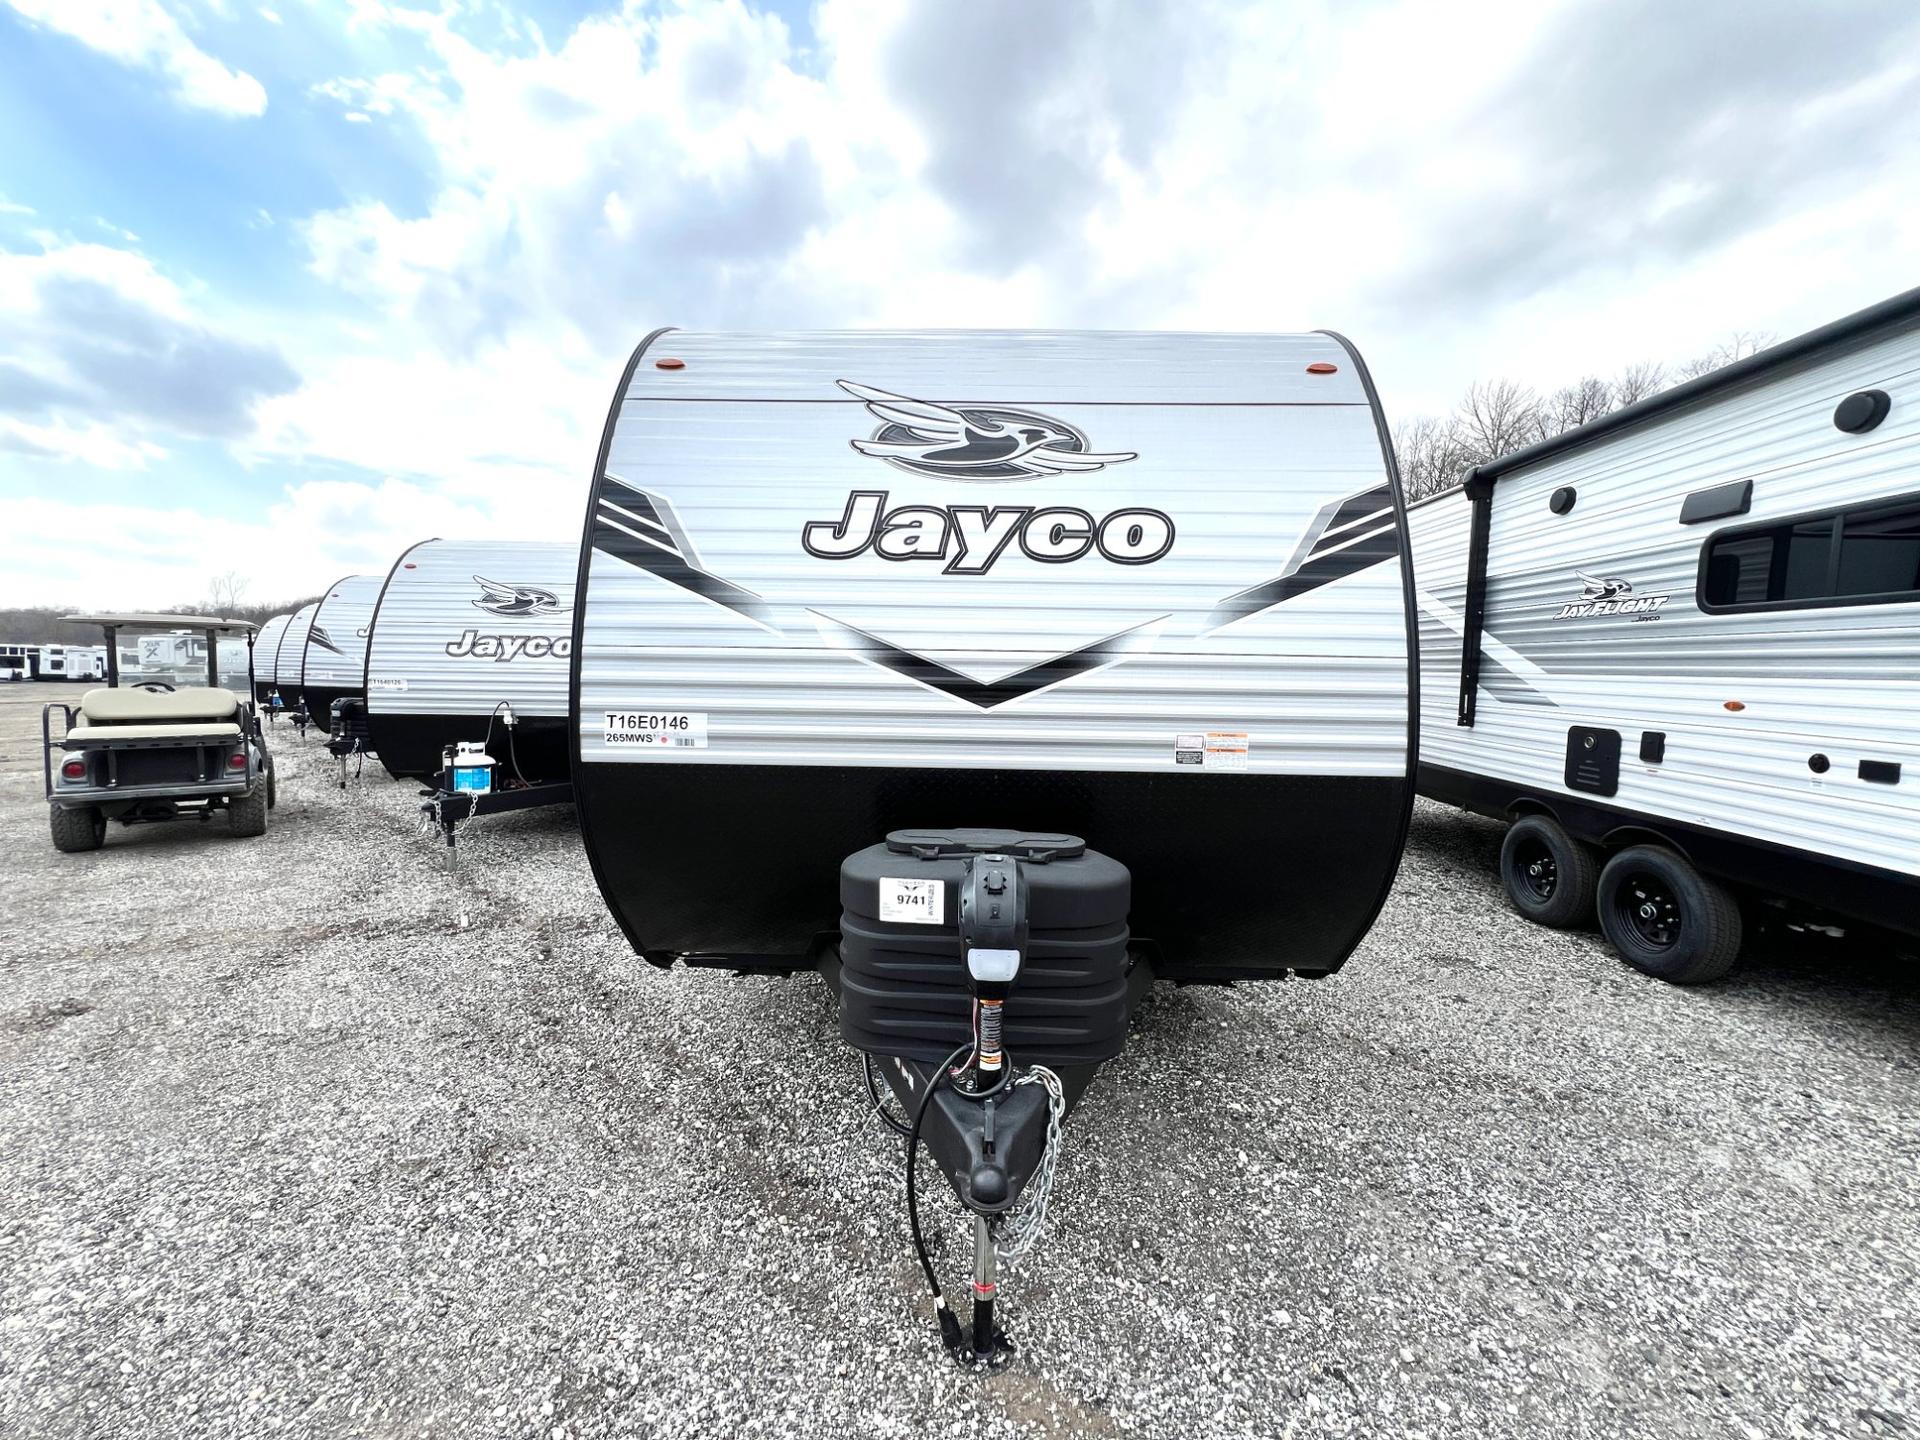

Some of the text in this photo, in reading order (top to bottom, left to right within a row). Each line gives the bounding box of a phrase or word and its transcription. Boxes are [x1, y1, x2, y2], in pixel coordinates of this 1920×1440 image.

[801, 490, 1175, 575] Jayco
[1587, 595, 1671, 616] FLIGHT
[1631, 615, 1661, 623] Jayco
[445, 629, 572, 662] Jayco
[606, 714, 689, 730] T16E0146
[897, 894, 925, 905] 9741
